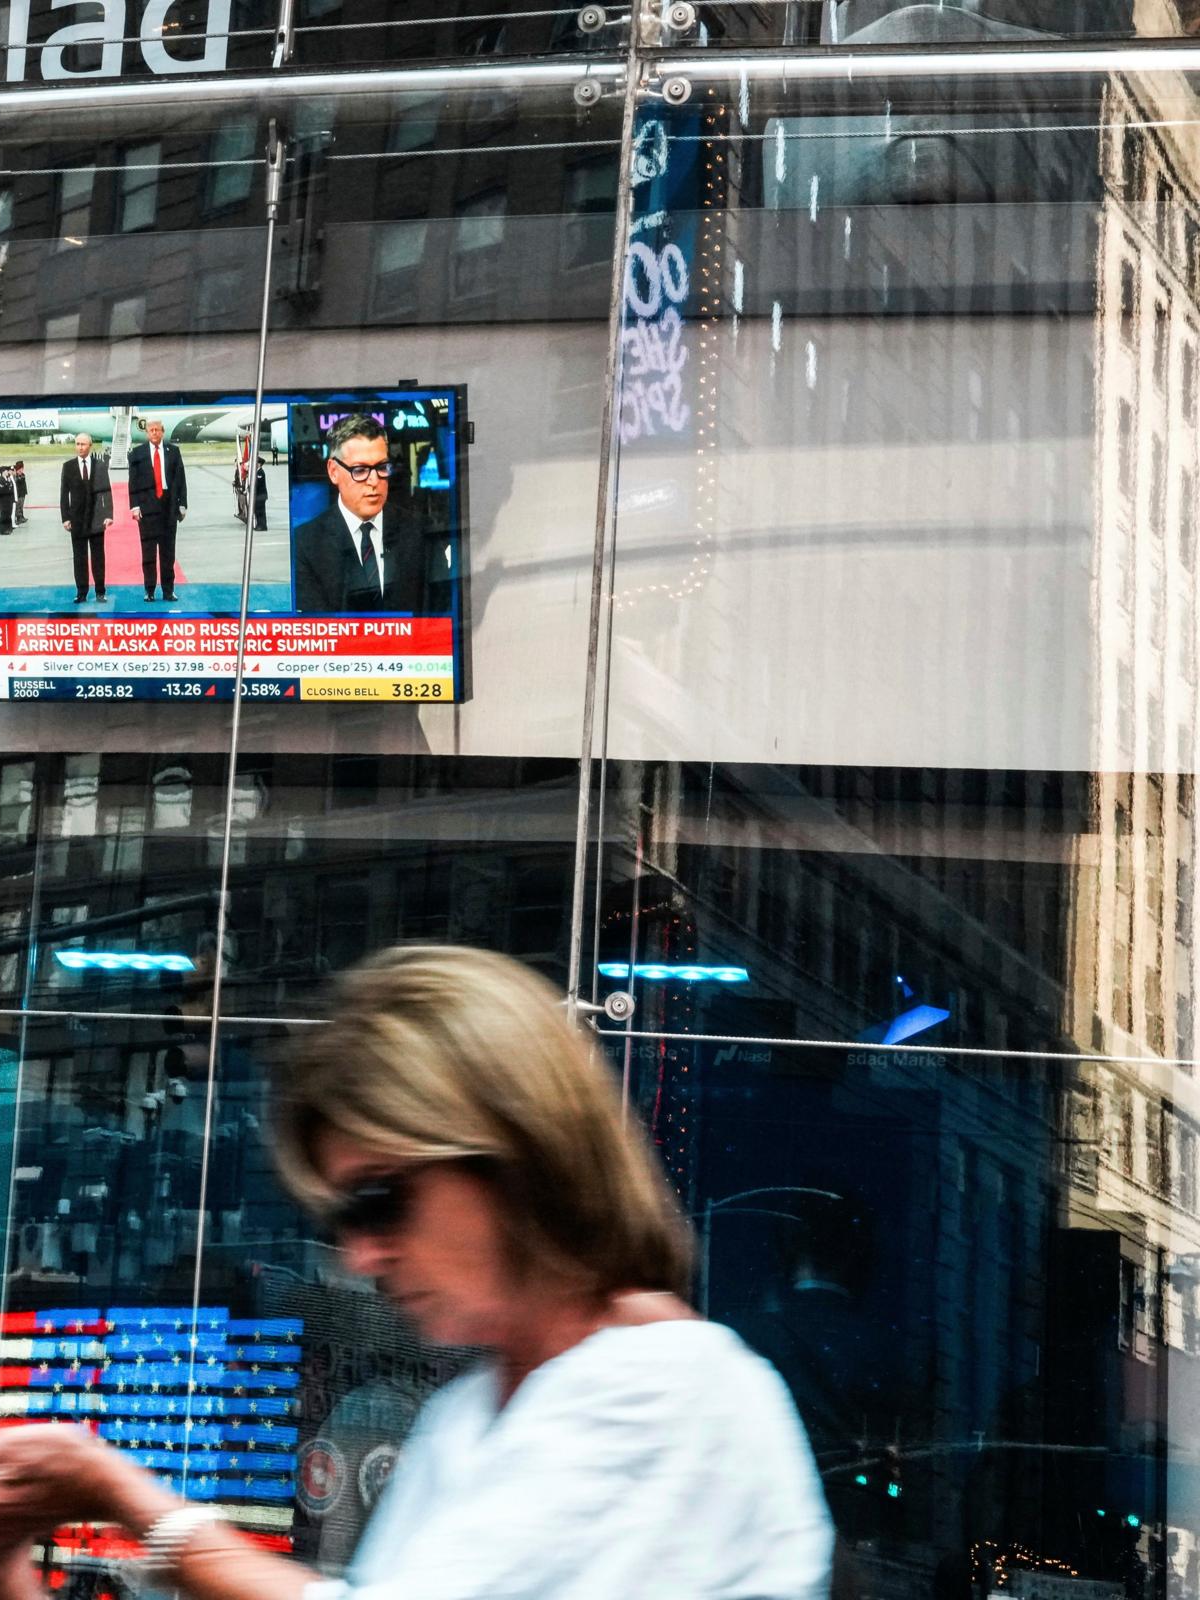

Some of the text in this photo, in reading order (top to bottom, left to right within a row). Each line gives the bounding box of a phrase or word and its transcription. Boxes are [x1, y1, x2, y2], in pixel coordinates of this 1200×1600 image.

[0, 411, 21, 420] AGO
[16, 419, 55, 429] ALASKA
[17, 623, 412, 637] PRESIDENT TRUMP AND RUSSAN PRESIDENT PUTIN
[18, 639, 338, 652] ARRIVE IN ALASKA FOR HISTORIC SUMMIT
[43, 661, 75, 671] Silver
[77, 662, 118, 671] COMEX
[123, 661, 171, 673] (Sep'25)
[174, 662, 204, 672] 37.98
[277, 663, 319, 674] Copper
[323, 662, 373, 674] (Sep'25)
[377, 663, 404, 672] 4.49
[13, 680, 56, 690] RUSSELL
[13, 689, 40, 698] 2000
[75, 684, 134, 699] 2,285.82
[161, 683, 201, 696] -13.26
[306, 684, 442, 698] CLOSING BELL 38:28
